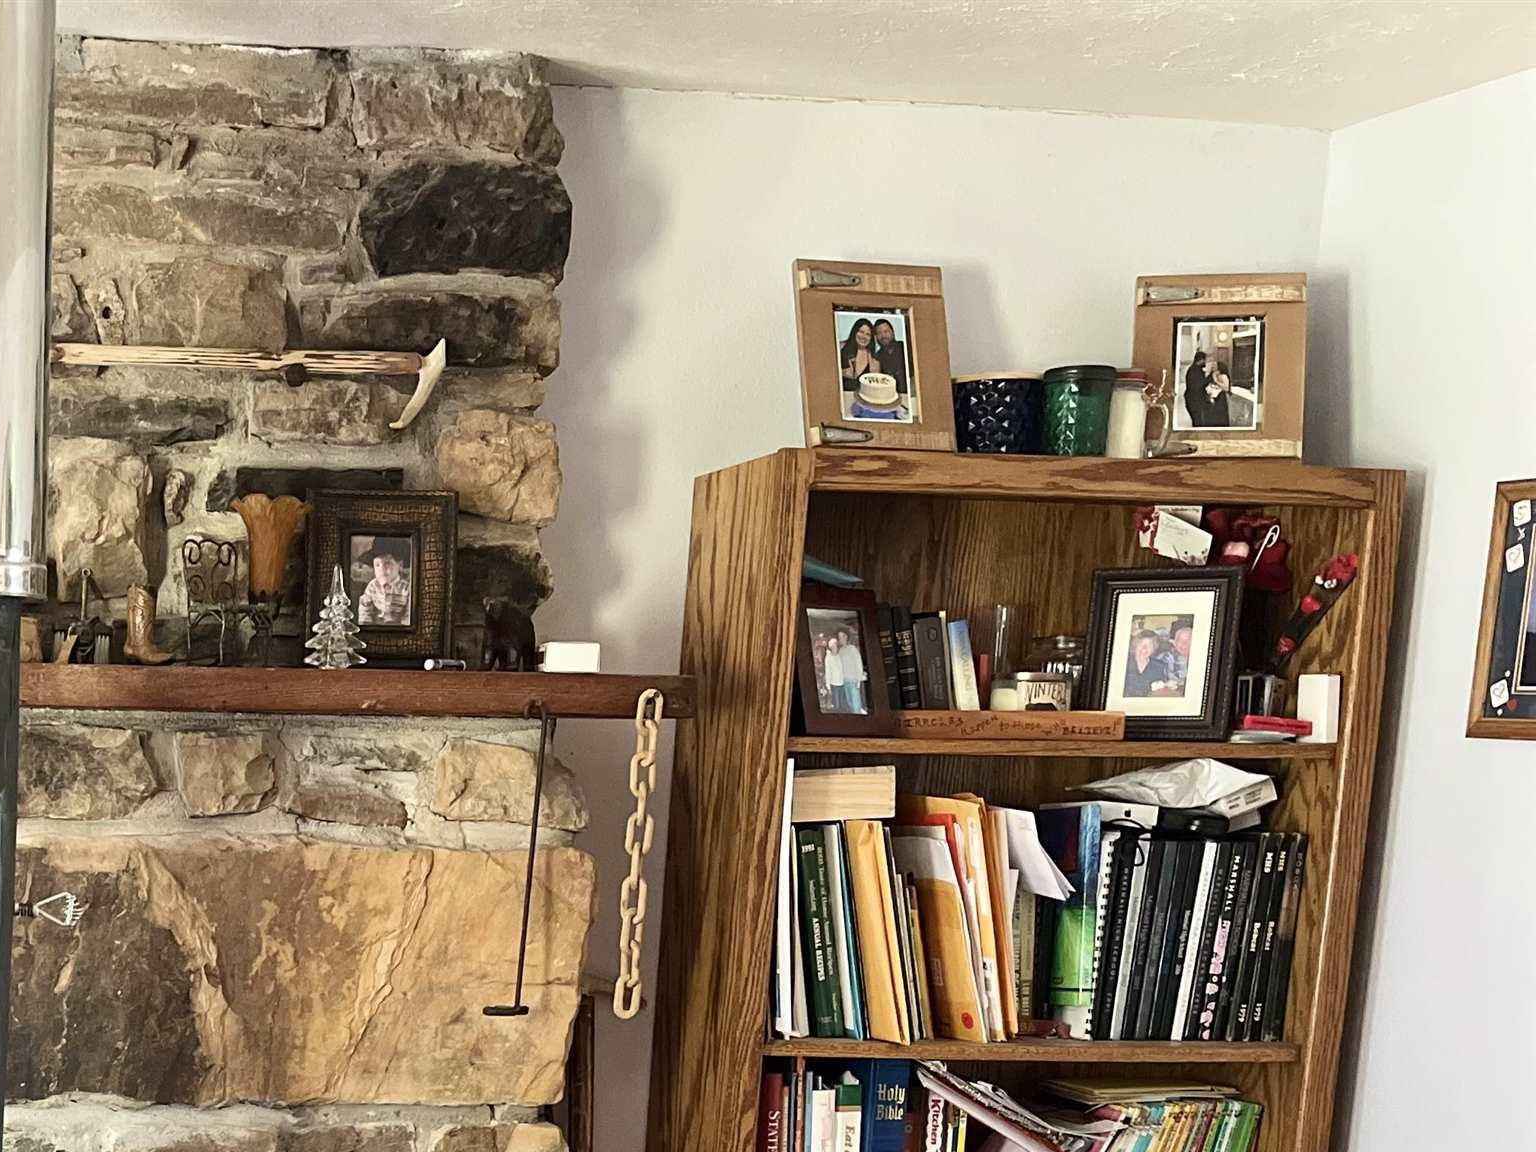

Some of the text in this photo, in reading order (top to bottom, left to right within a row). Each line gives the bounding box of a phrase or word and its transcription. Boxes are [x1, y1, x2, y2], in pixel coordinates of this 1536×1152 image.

[1225, 854, 1241, 912] MARSHALL
[812, 917, 826, 982] ANNUAL RECIPES
[1238, 852, 1274, 1023] MHS Bobcat 1979
[1253, 851, 1287, 1022] MHS Bobcat 1979
[876, 1083, 906, 1105] Holy
[876, 1104, 904, 1121] Bible
[844, 1125, 855, 1148] Eat
[931, 1098, 942, 1145] Kitchen
